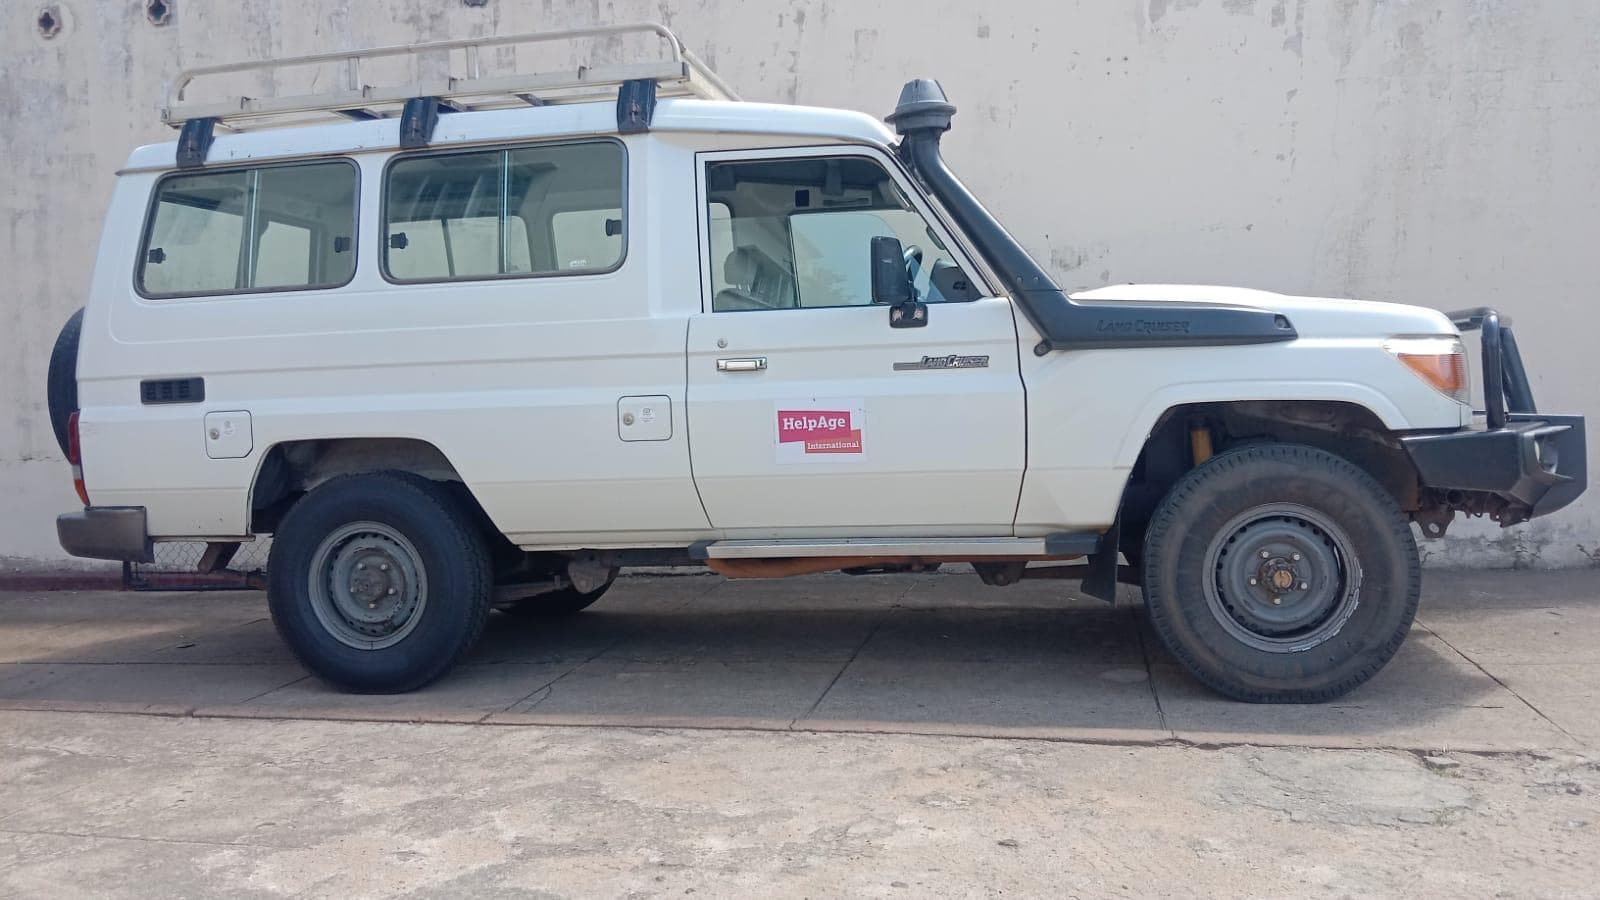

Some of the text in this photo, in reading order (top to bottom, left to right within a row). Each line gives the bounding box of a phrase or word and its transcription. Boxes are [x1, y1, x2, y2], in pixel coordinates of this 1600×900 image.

[1096, 319, 1191, 334] LAND CRUISER
[783, 416, 846, 431] HelpAge
[807, 441, 860, 450] International
